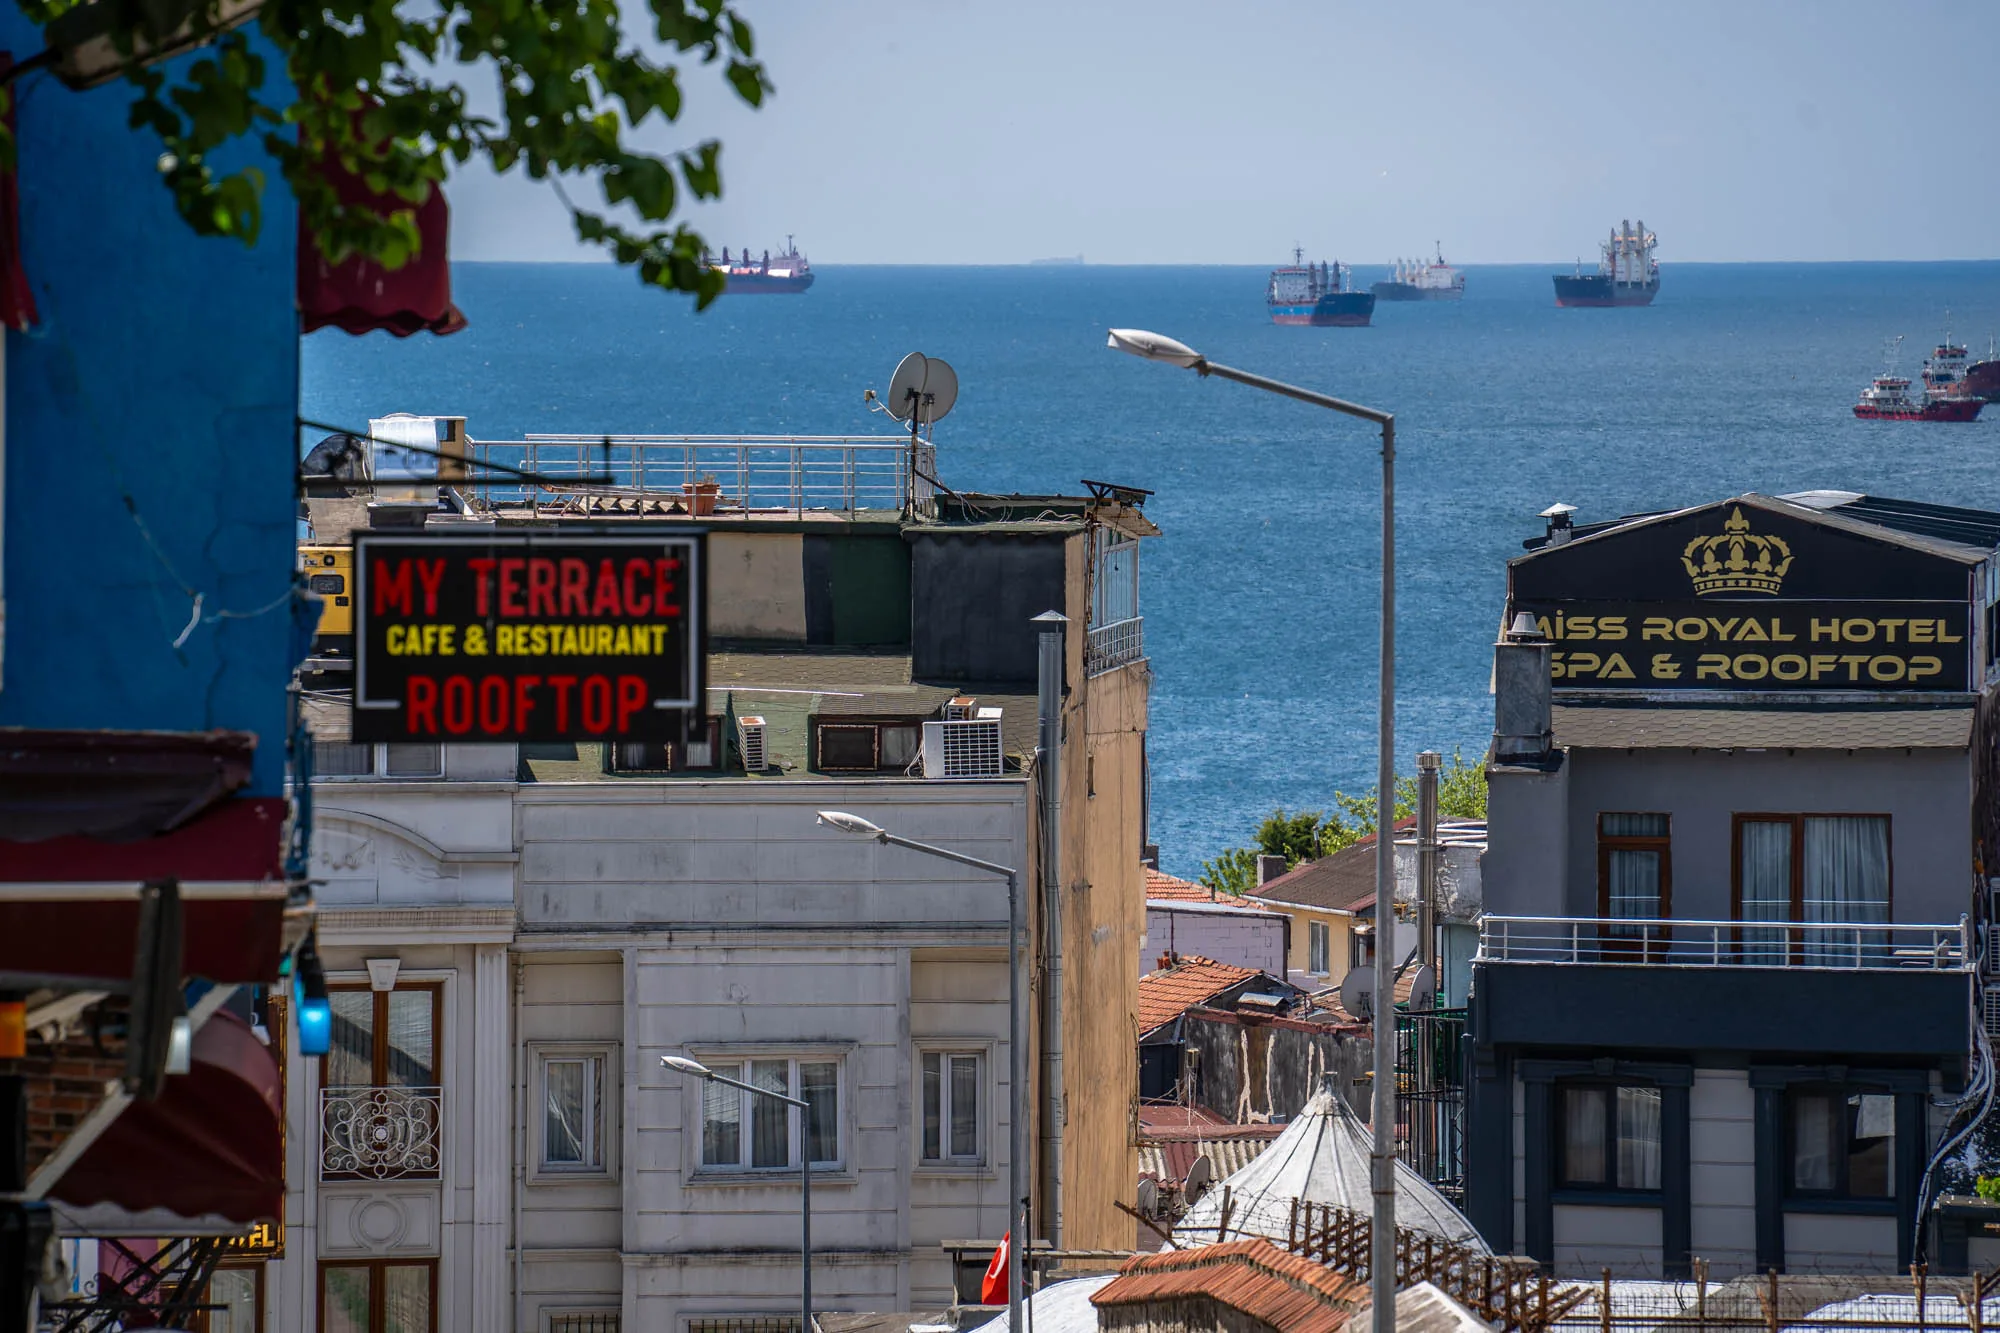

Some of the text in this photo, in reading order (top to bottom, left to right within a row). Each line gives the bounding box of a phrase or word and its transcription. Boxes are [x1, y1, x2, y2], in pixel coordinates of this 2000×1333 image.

[373, 557, 681, 618] MY TERRACE
[386, 624, 667, 656] CAFE & RESTAURANT
[1642, 617, 1797, 642] ROYAL
[1810, 618, 1963, 643] HOTEL
[1651, 653, 1681, 680] &
[1696, 654, 1942, 682] ROOFTOP
[406, 674, 649, 735] ROOFTOP
